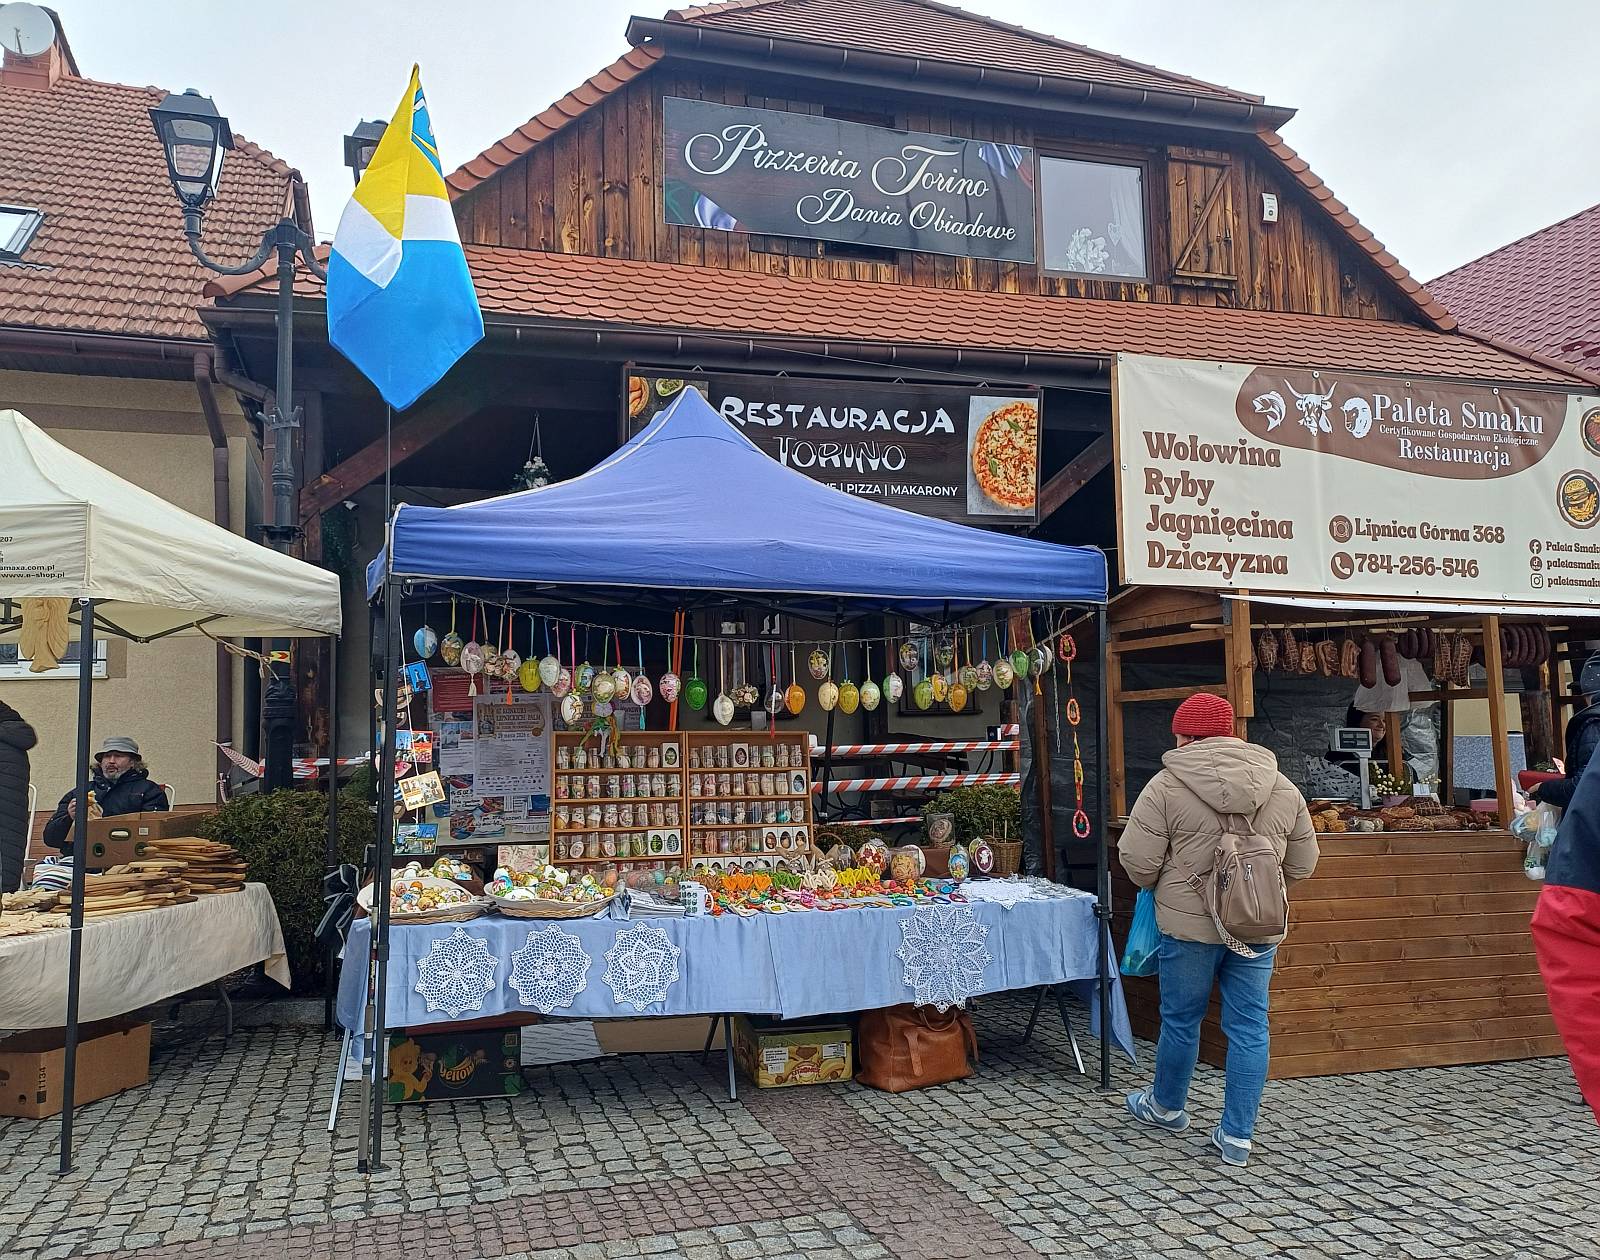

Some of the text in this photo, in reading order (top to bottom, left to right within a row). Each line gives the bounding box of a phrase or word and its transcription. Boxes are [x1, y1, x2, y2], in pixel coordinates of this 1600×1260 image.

[684, 124, 989, 197] Pizzeria Torino
[797, 188, 1016, 241] Dania Obiadowe
[720, 397, 955, 435] RESTAURACJA
[1372, 394, 1544, 434] Paleta Smaku
[1143, 431, 1281, 467] Wołowina
[1379, 425, 1539, 446] Certyfikowane Gospodarstwo Ekologiczne
[1398, 437, 1511, 471] Restauracja
[773, 436, 908, 473] TORINO
[846, 483, 882, 495] PIZZA
[890, 484, 958, 497] MAKARONY
[1144, 468, 1214, 506] Ryby
[1146, 505, 1293, 542] Jagnięcina
[1355, 518, 1505, 543] Lipnica Górna 368
[1147, 541, 1288, 580] Dziczyzna
[1354, 553, 1480, 578] 784-256-546
[1545, 541, 1600, 554] Paleta Smak
